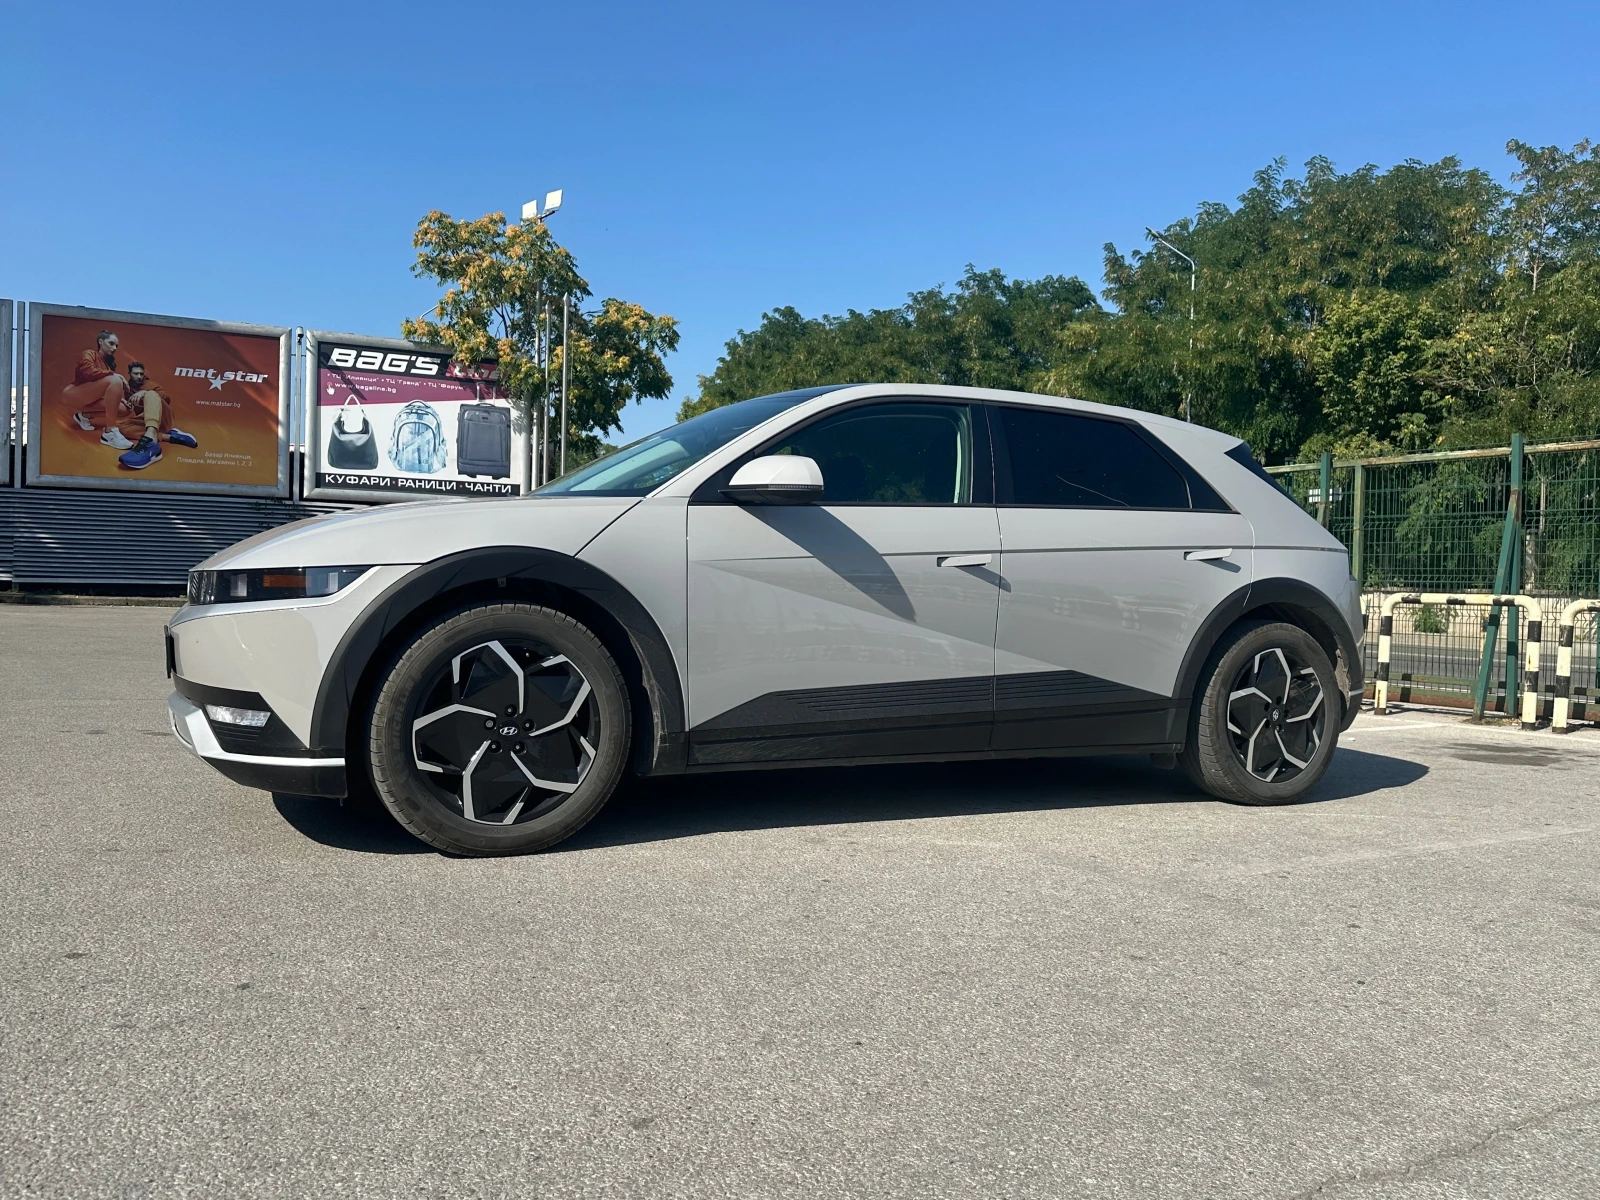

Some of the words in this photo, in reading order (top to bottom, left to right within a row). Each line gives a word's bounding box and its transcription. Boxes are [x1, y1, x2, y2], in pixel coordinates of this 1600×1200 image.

[325, 474, 391, 487] КУФАРИ
[397, 478, 457, 491] РАНИЦИ
[464, 482, 512, 493] ЧАНТИ
